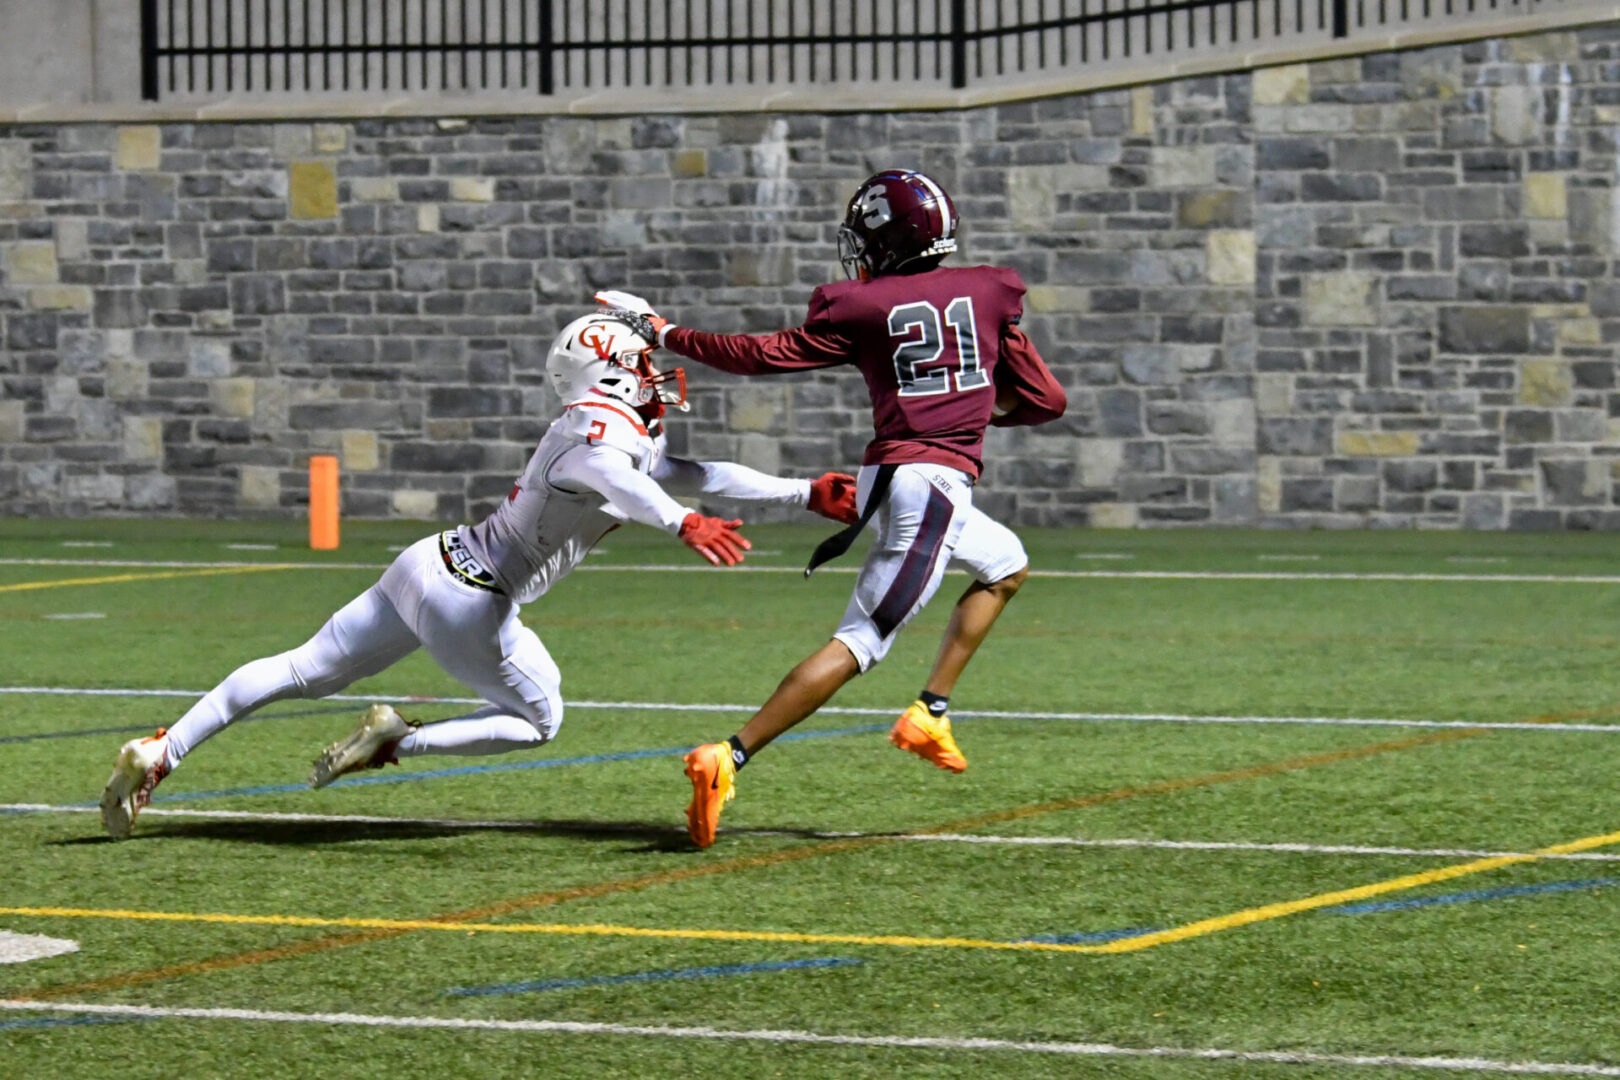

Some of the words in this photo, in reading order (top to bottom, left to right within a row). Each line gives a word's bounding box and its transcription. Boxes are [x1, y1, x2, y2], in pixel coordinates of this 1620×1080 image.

[861, 183, 893, 230] S
[578, 324, 616, 361] CV
[887, 296, 991, 397] 21
[932, 474, 953, 494] STATE
